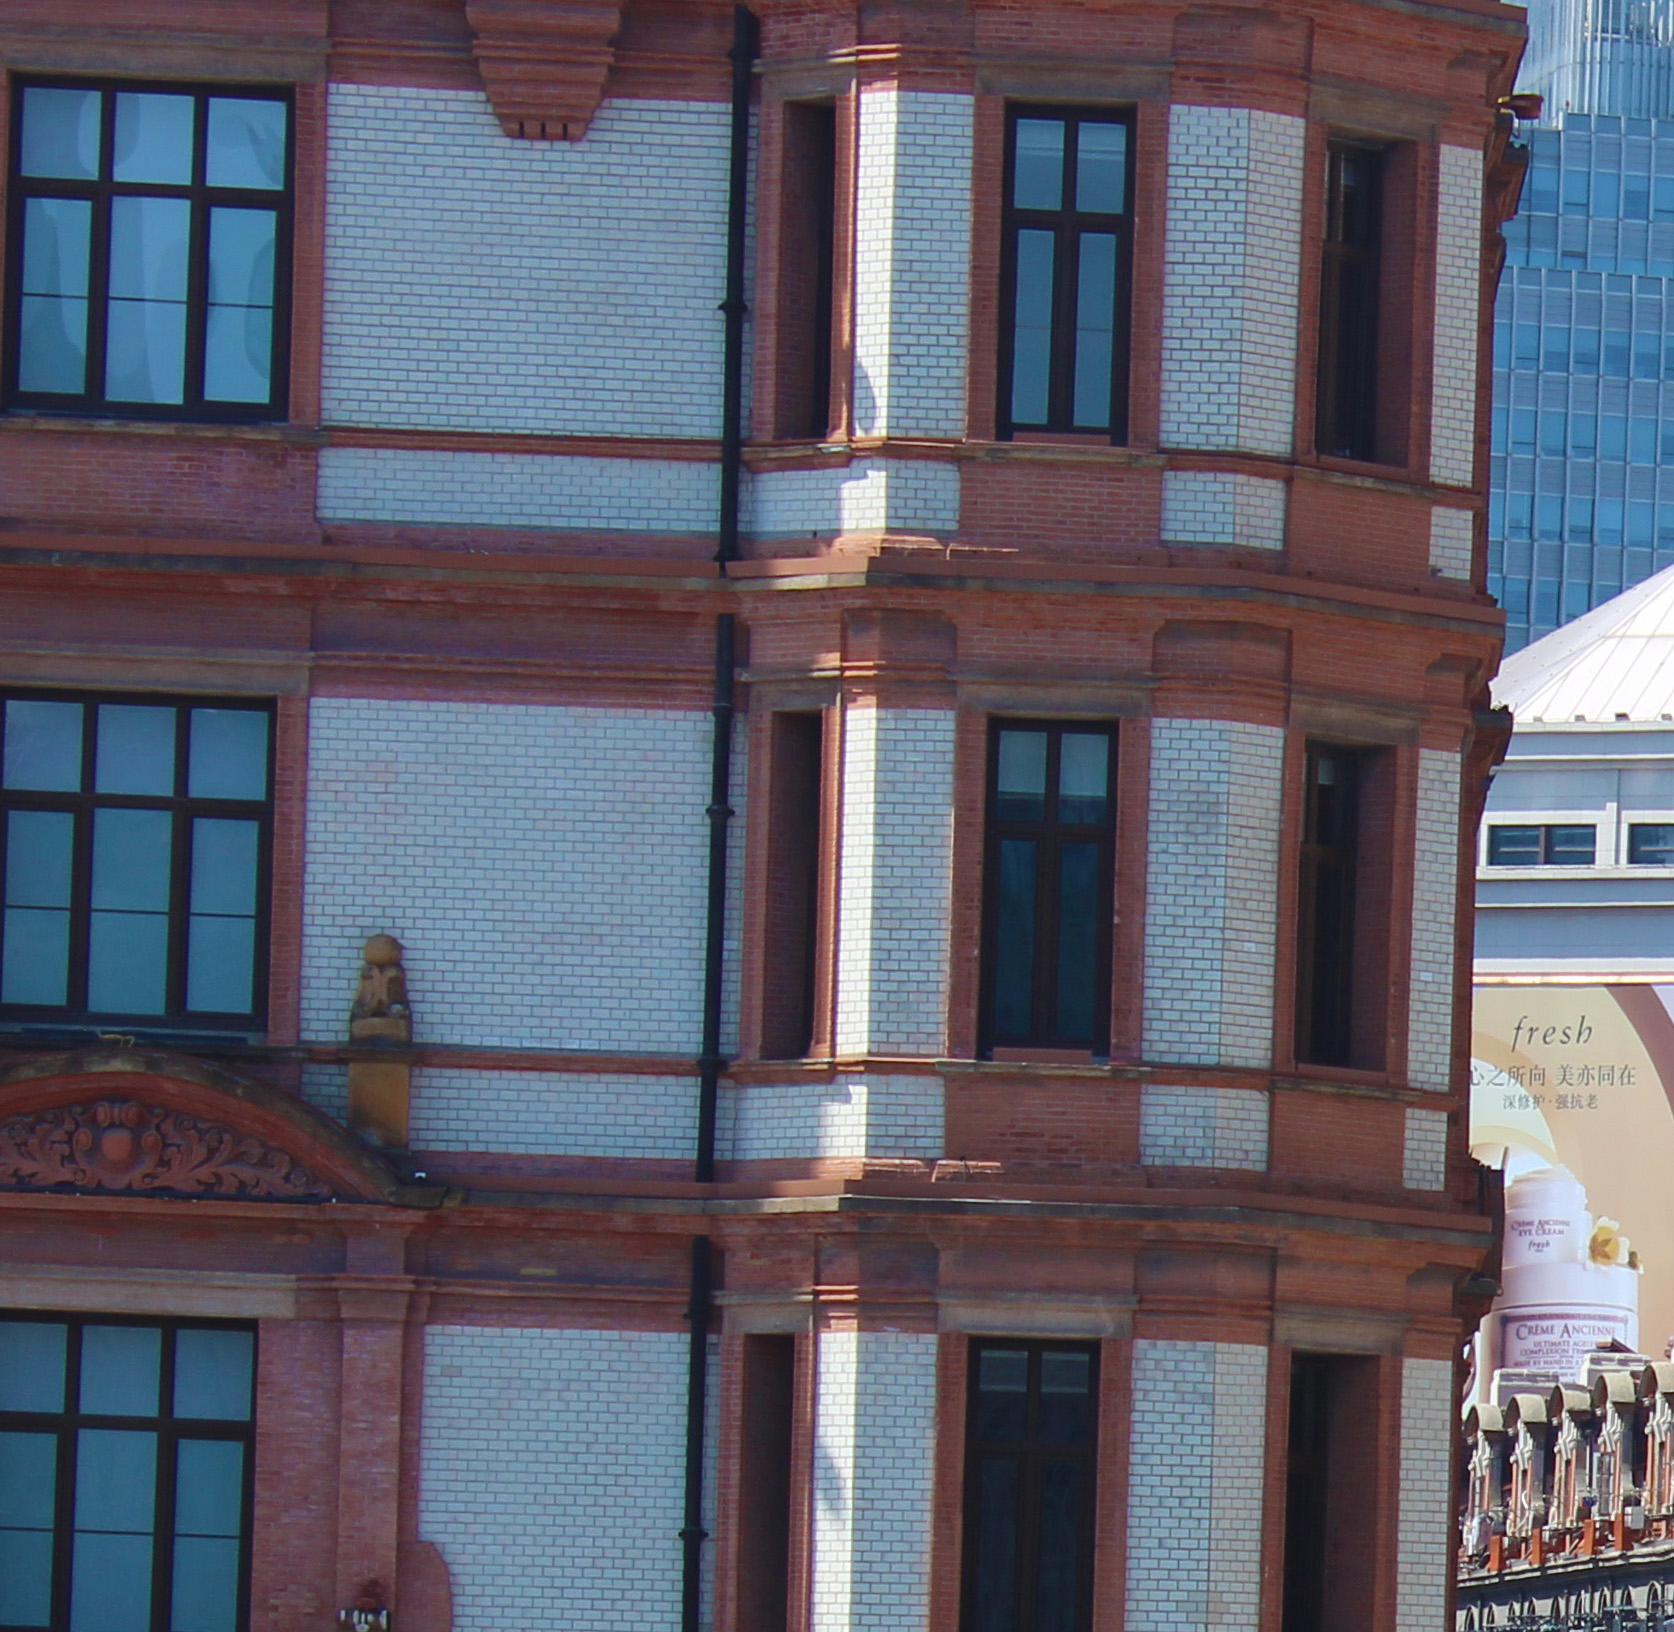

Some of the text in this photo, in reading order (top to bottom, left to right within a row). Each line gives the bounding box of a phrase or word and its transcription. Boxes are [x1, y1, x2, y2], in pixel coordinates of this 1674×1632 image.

[1511, 1015, 1593, 1053] fresh
[1470, 1064, 1637, 1086] 心之所向 美亦同在
[1528, 1239, 1551, 1251] fresh
[1533, 1340, 1570, 1348] ULTIMATE
